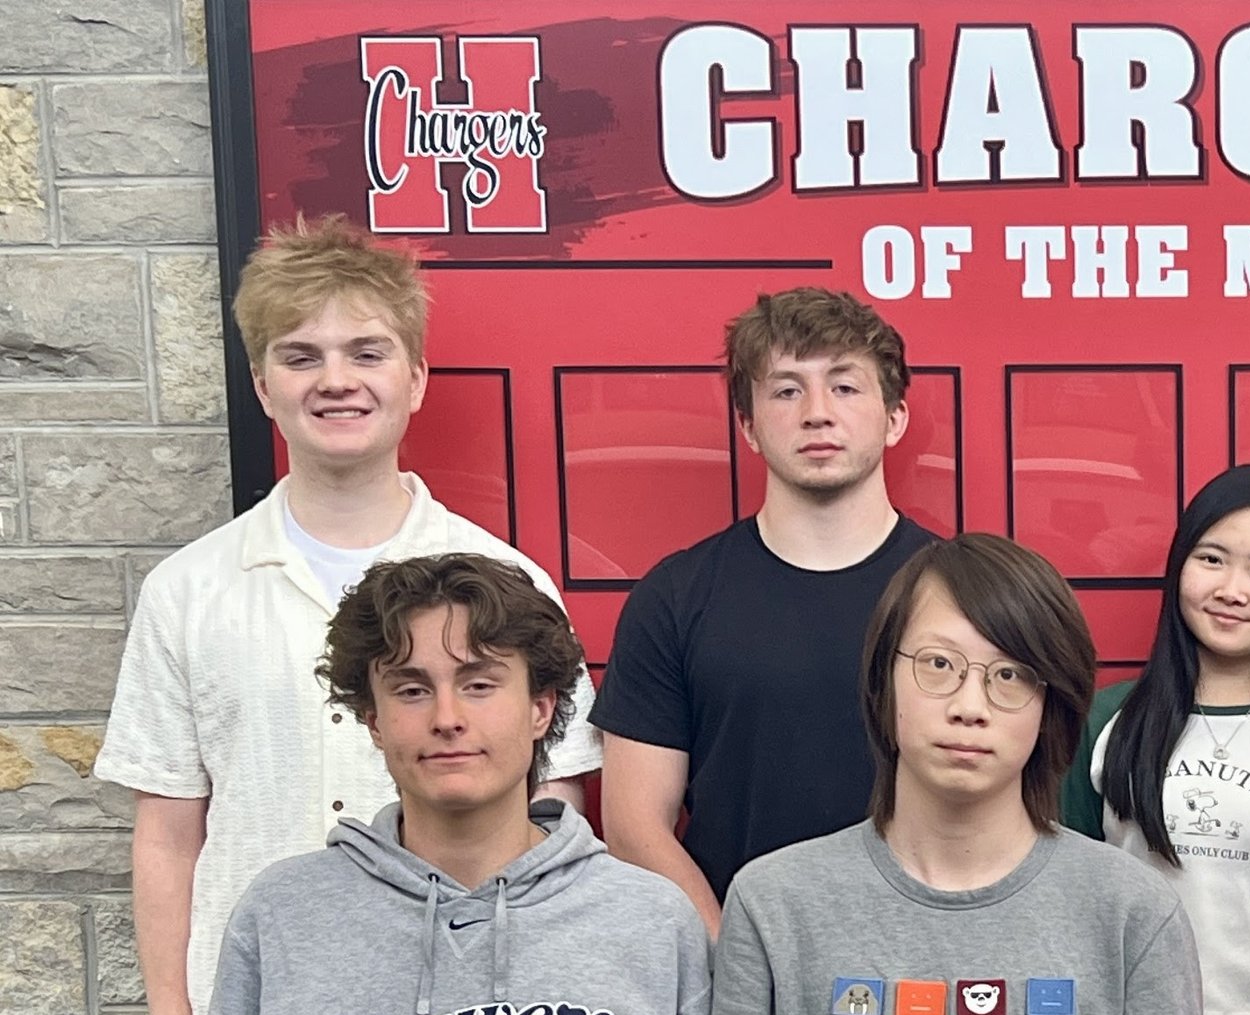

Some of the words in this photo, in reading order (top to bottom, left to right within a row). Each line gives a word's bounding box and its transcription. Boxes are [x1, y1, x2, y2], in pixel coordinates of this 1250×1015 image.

[365, 66, 547, 208] Chargers
[862, 224, 973, 299] OF
[1005, 224, 1189, 299] THE
[1191, 846, 1220, 858] ONLY
[1220, 848, 1250, 861] CLUB
